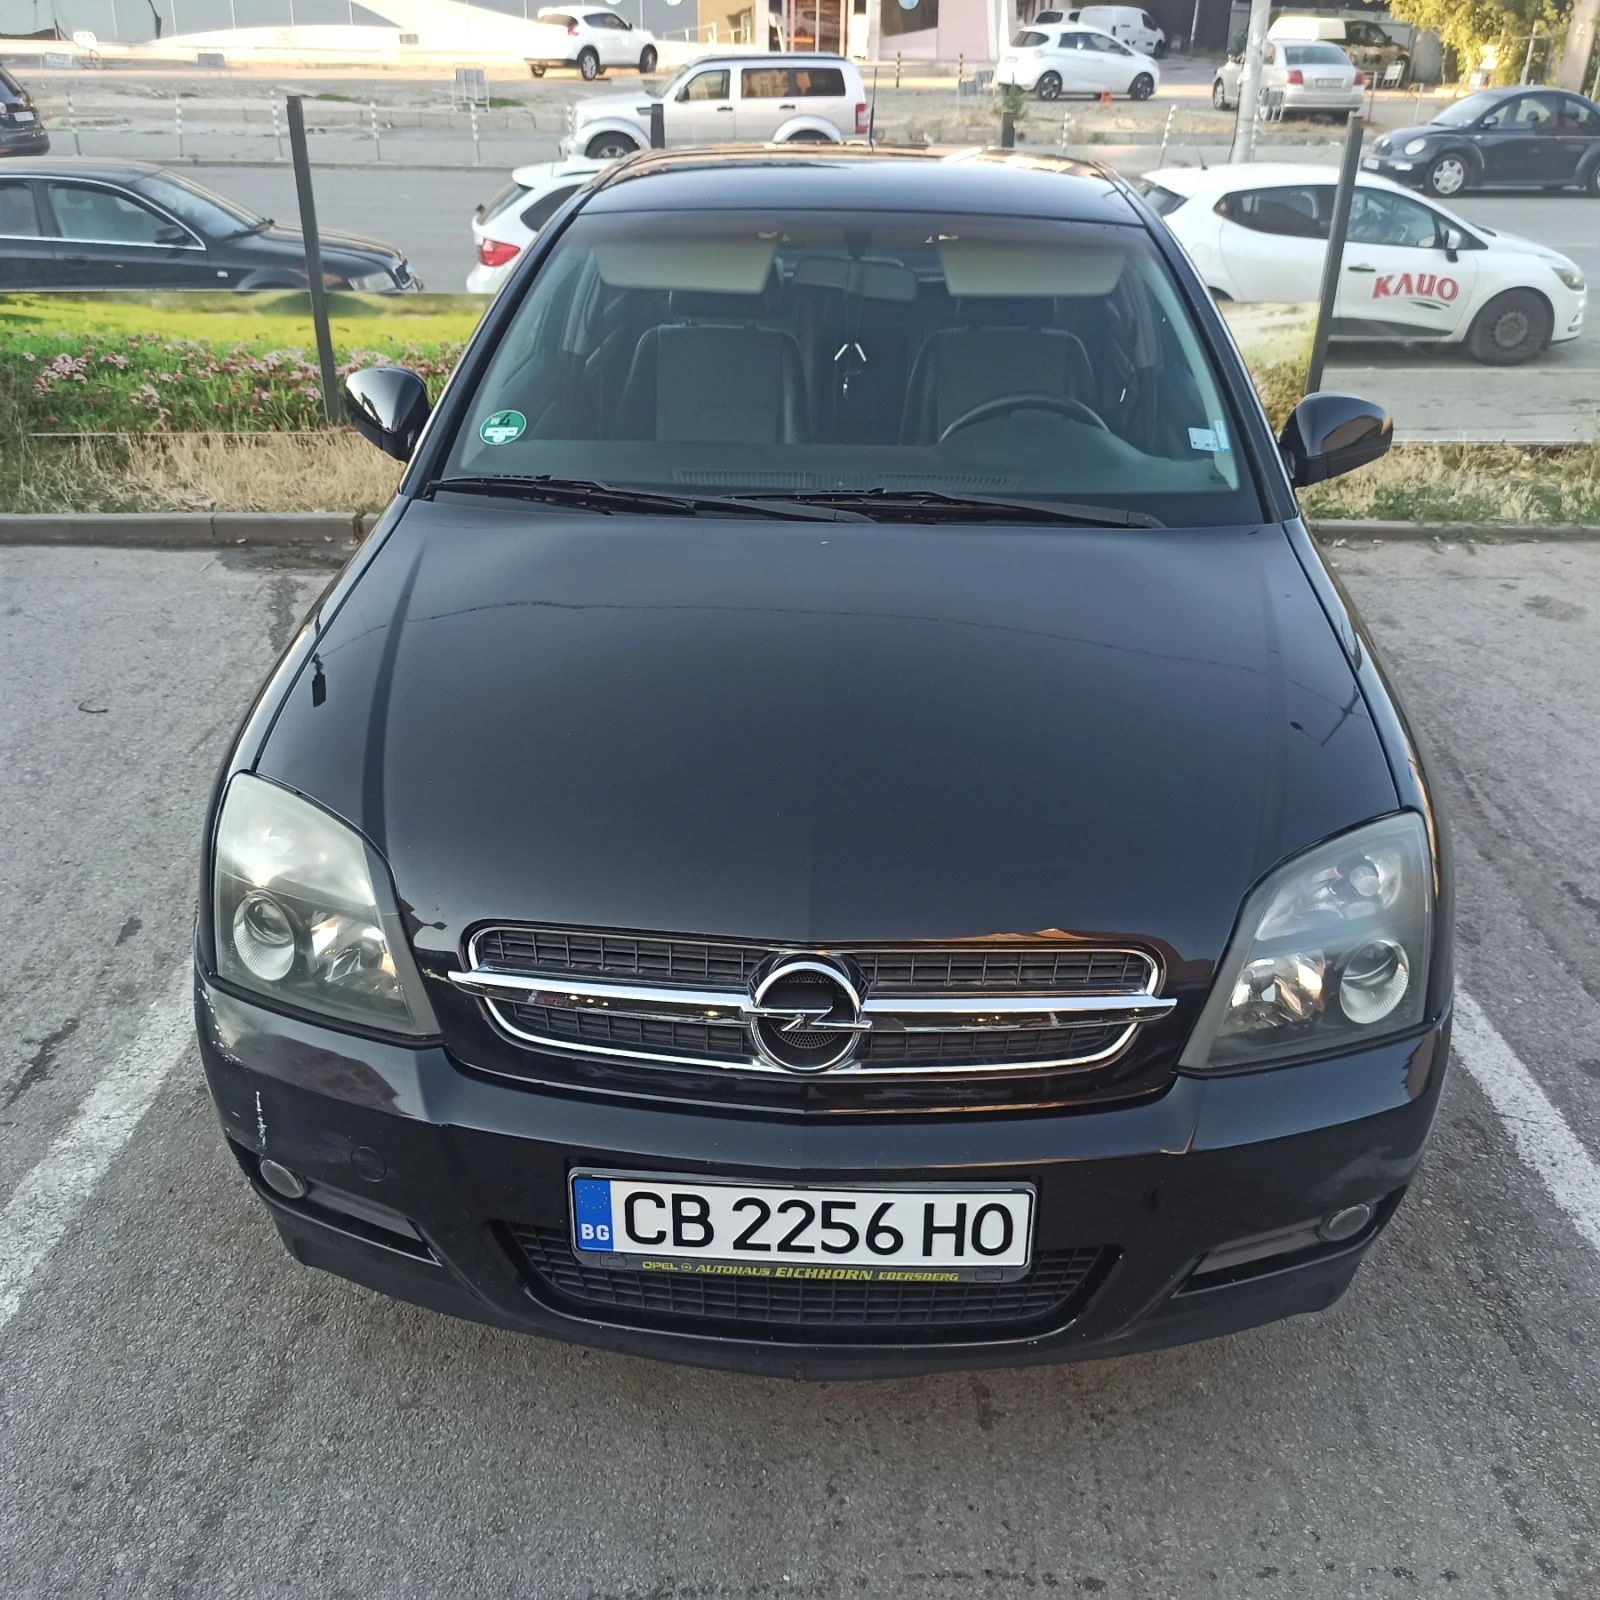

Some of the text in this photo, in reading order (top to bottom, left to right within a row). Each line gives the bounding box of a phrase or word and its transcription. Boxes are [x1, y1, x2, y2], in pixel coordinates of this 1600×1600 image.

[498, 412, 511, 427] 4
[581, 1223, 610, 1241] BG
[624, 1191, 1013, 1256] CB 2256 HO
[642, 1261, 960, 1282] OPEL AUTOHAUS EICHHORN EBERSBERG
